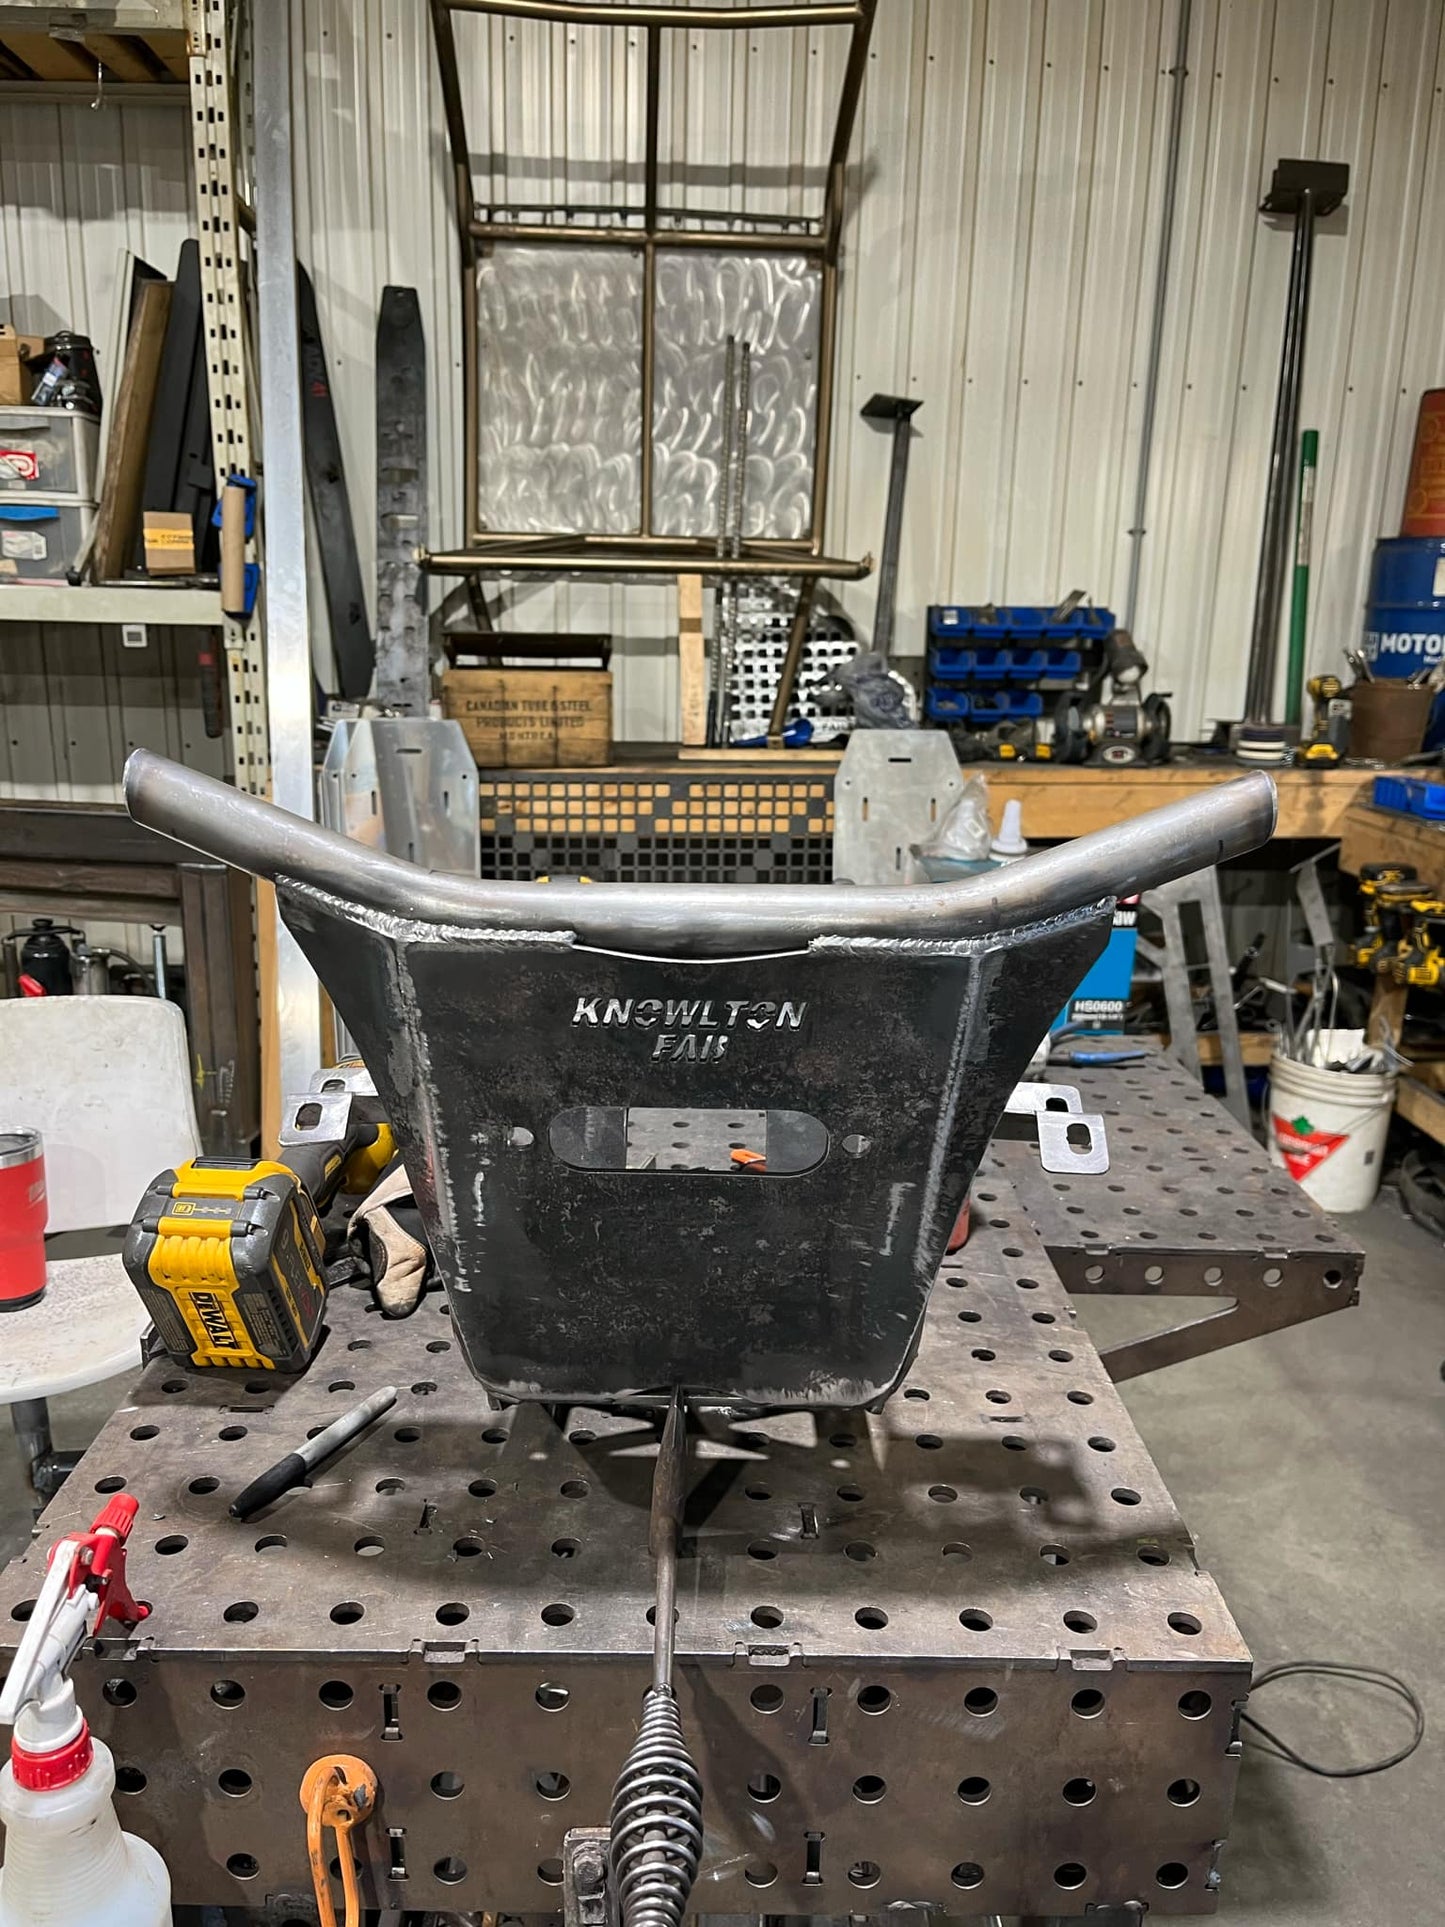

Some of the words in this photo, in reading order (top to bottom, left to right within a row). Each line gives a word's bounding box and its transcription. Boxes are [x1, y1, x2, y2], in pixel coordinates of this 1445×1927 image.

[1380, 633, 1445, 655] MOTO
[466, 700, 518, 712] CANADIAN
[522, 700, 548, 712] TUBE
[560, 700, 591, 712] STEEL
[476, 716, 536, 728] PRODUCTS
[540, 716, 585, 728] LIMITED
[499, 731, 557, 741] MONTREA
[571, 997, 808, 1030] KNOWLTON
[651, 1034, 729, 1063] FAB
[191, 1292, 238, 1349] DEWALT
